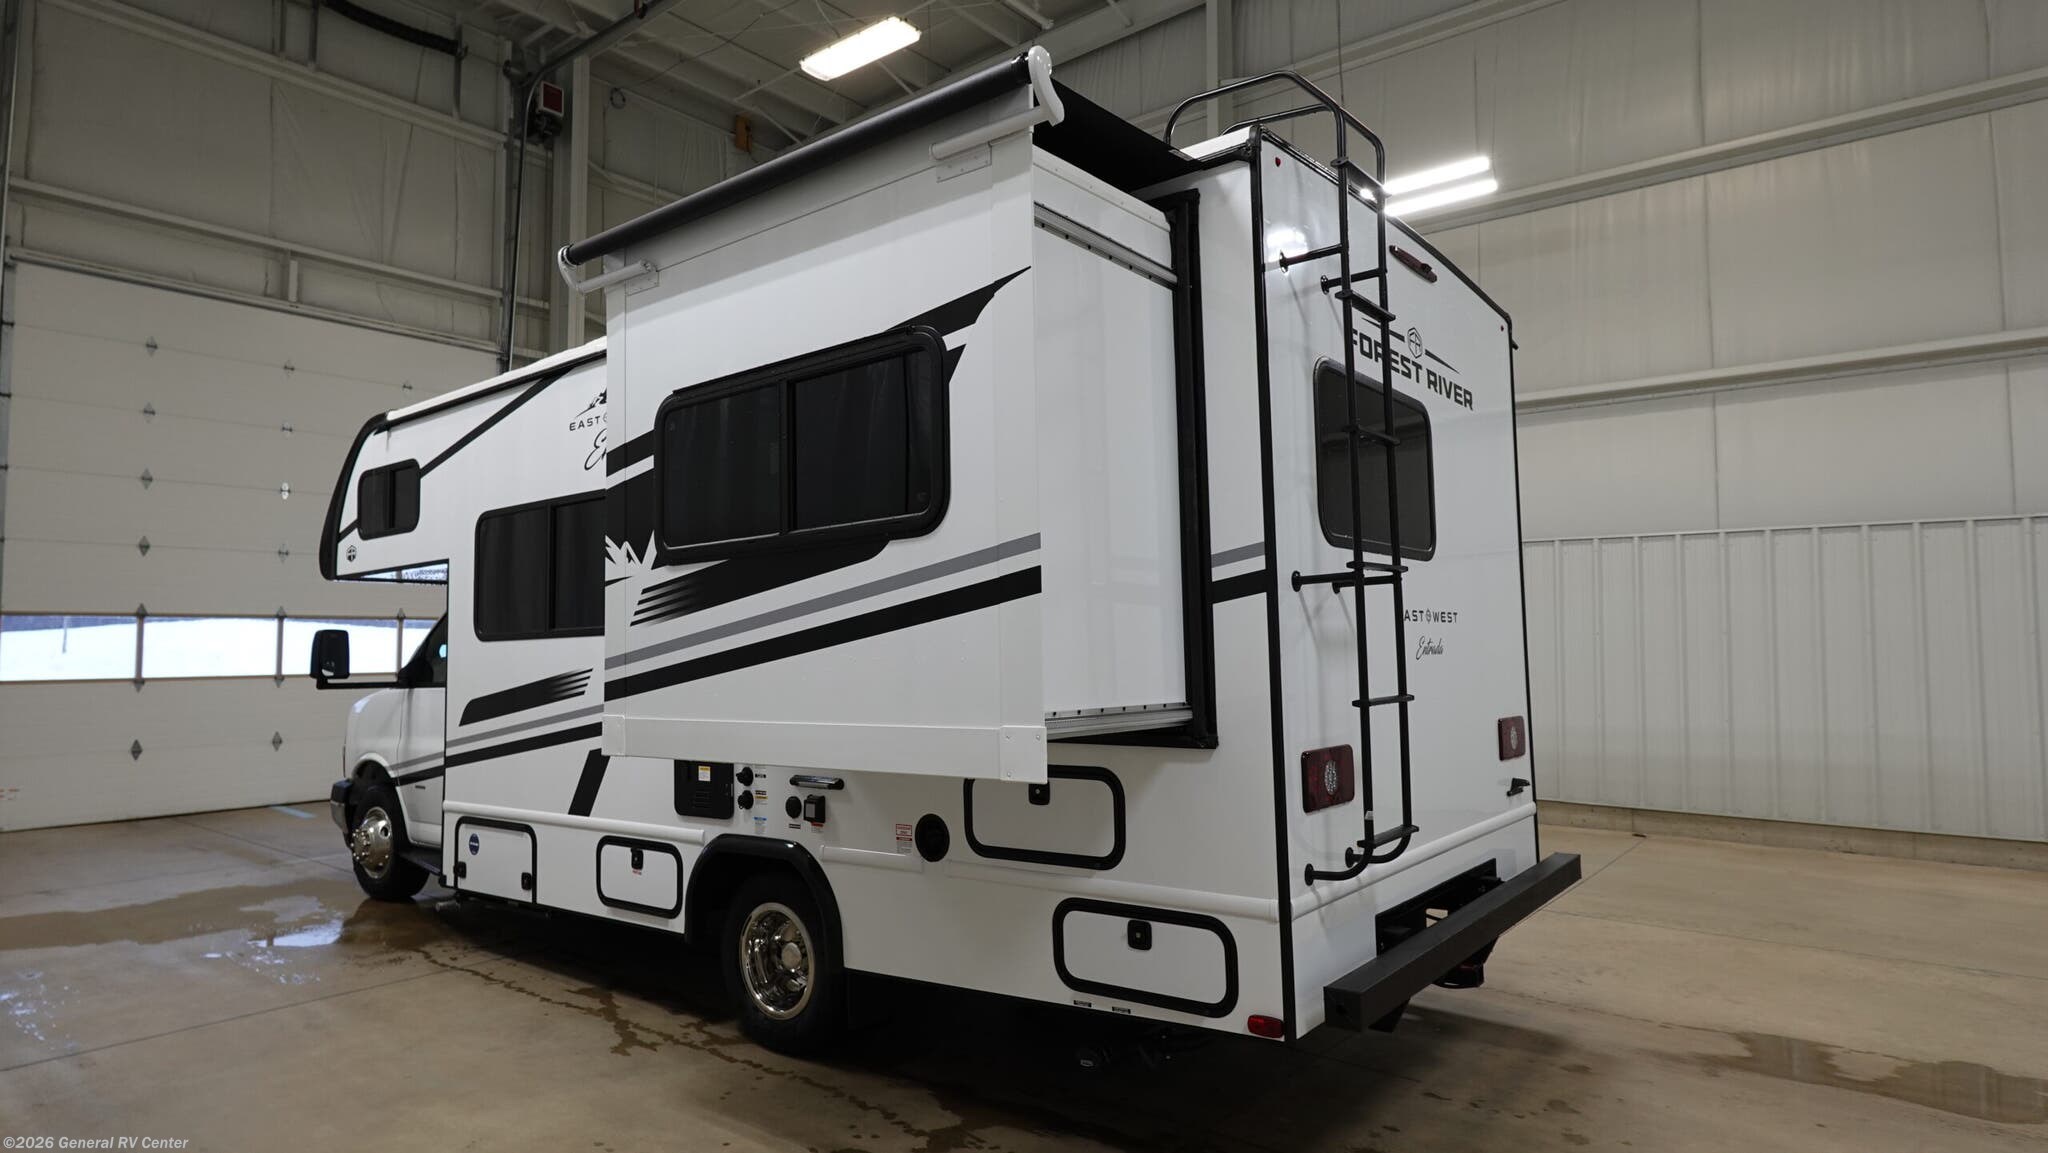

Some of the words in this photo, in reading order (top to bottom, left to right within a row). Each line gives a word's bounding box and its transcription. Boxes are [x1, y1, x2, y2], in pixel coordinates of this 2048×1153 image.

[1426, 368, 1473, 410] RIVER
[569, 415, 601, 432] EAST
[1403, 609, 1424, 622] AST
[1432, 611, 1458, 623] WEST
